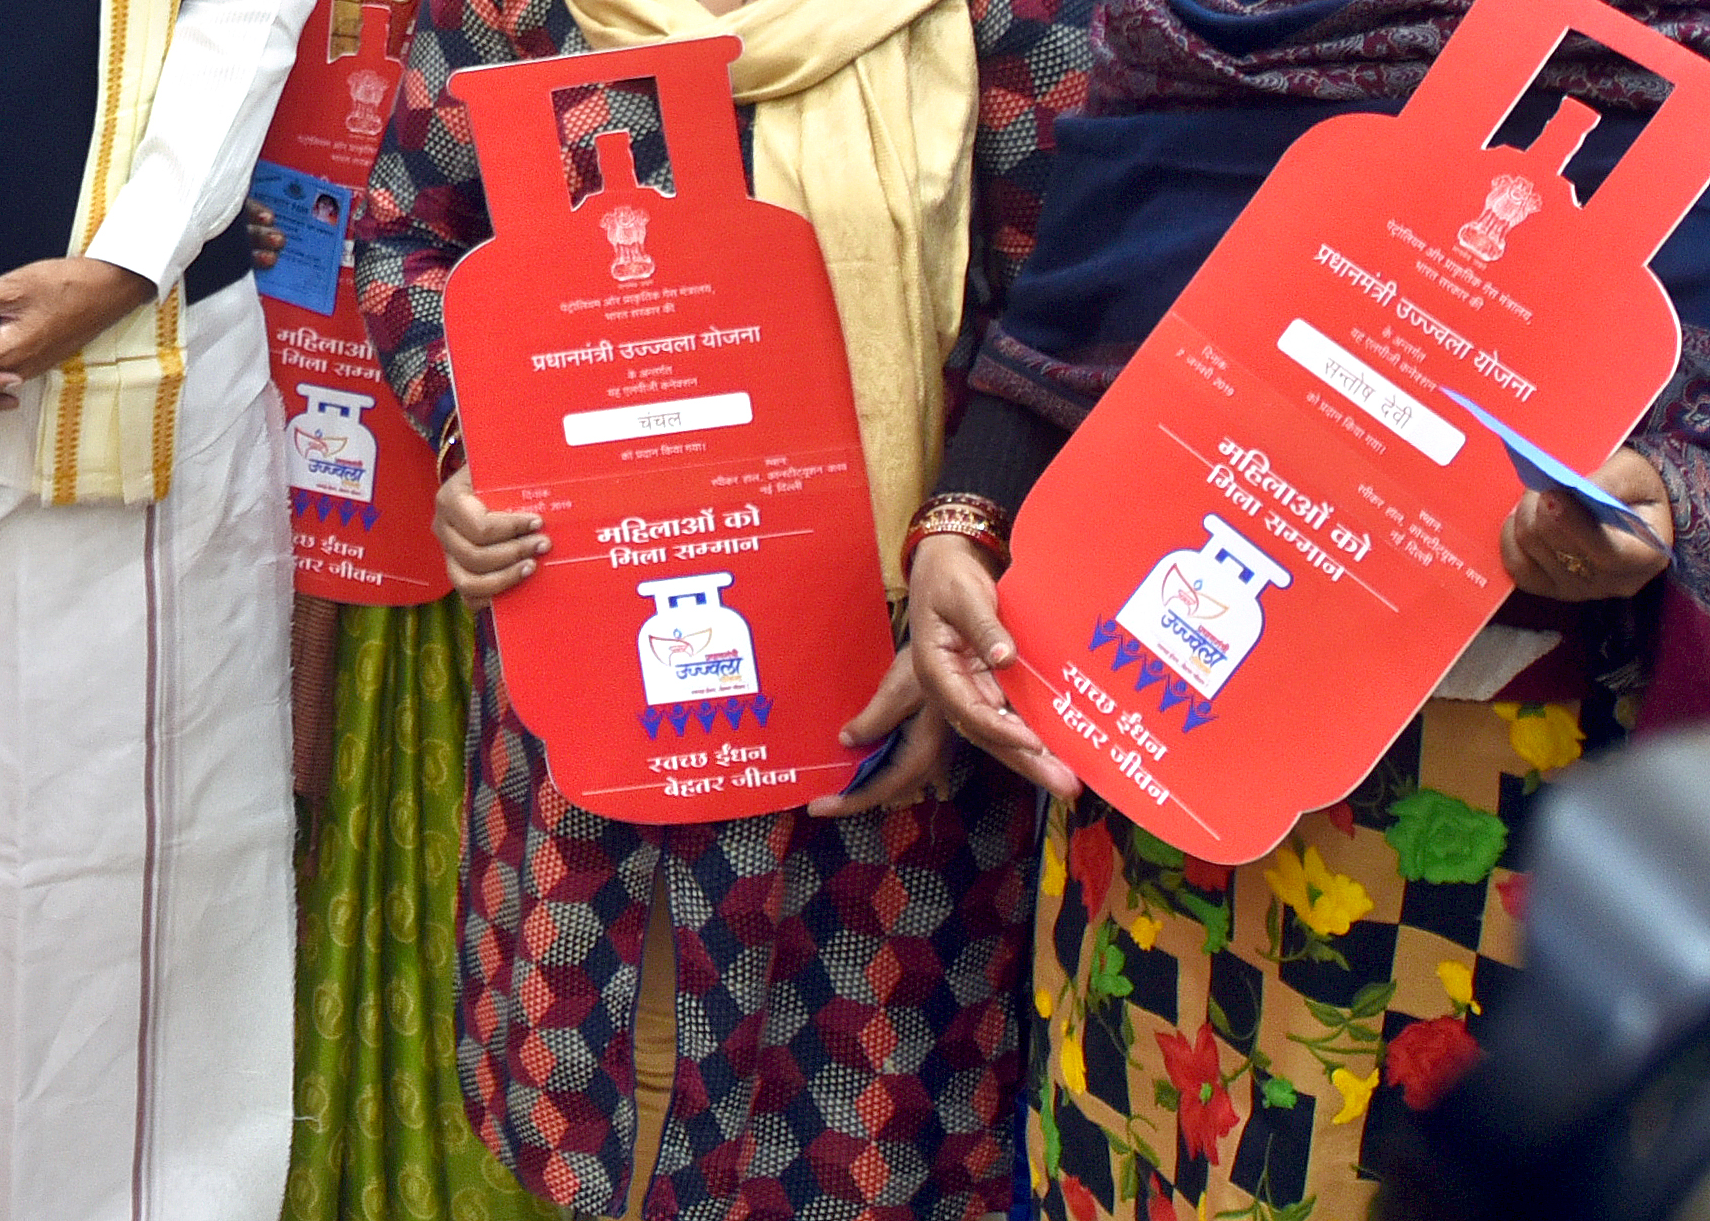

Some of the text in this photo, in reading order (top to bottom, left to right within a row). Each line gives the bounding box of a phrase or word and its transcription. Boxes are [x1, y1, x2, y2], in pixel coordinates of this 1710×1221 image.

[1415, 259, 1439, 281] भारत
[1424, 246, 1445, 264] और
[1313, 243, 1397, 306] प्रधानमंत्री
[1395, 296, 1474, 359] उज्ज्वला
[1473, 349, 1537, 402] योजना
[281, 347, 327, 372] मिला
[530, 325, 760, 371] प्रधानमंत्री उज्ज्वला योजना
[1324, 357, 1412, 429] सन्तोष देवी
[637, 411, 682, 430] चंचल
[1217, 436, 1372, 562] महिलाओं को
[595, 503, 760, 543] महिलाओं को
[1205, 463, 1347, 581] मिला सम्मान
[320, 534, 364, 559] ईंधन
[608, 535, 759, 568] मिला सम्मान
[328, 559, 383, 585] जीवन
[1160, 608, 1228, 667] उज्ज्वला
[674, 656, 744, 680] उज्ज्वला
[1062, 661, 1117, 714] स्वच्छ
[1115, 710, 1168, 761] ईंधन
[647, 742, 767, 772] स्वच्छ ईंधन
[1052, 690, 1171, 805] बेहतर जीवन
[661, 766, 796, 797] बेहतर जीवन
